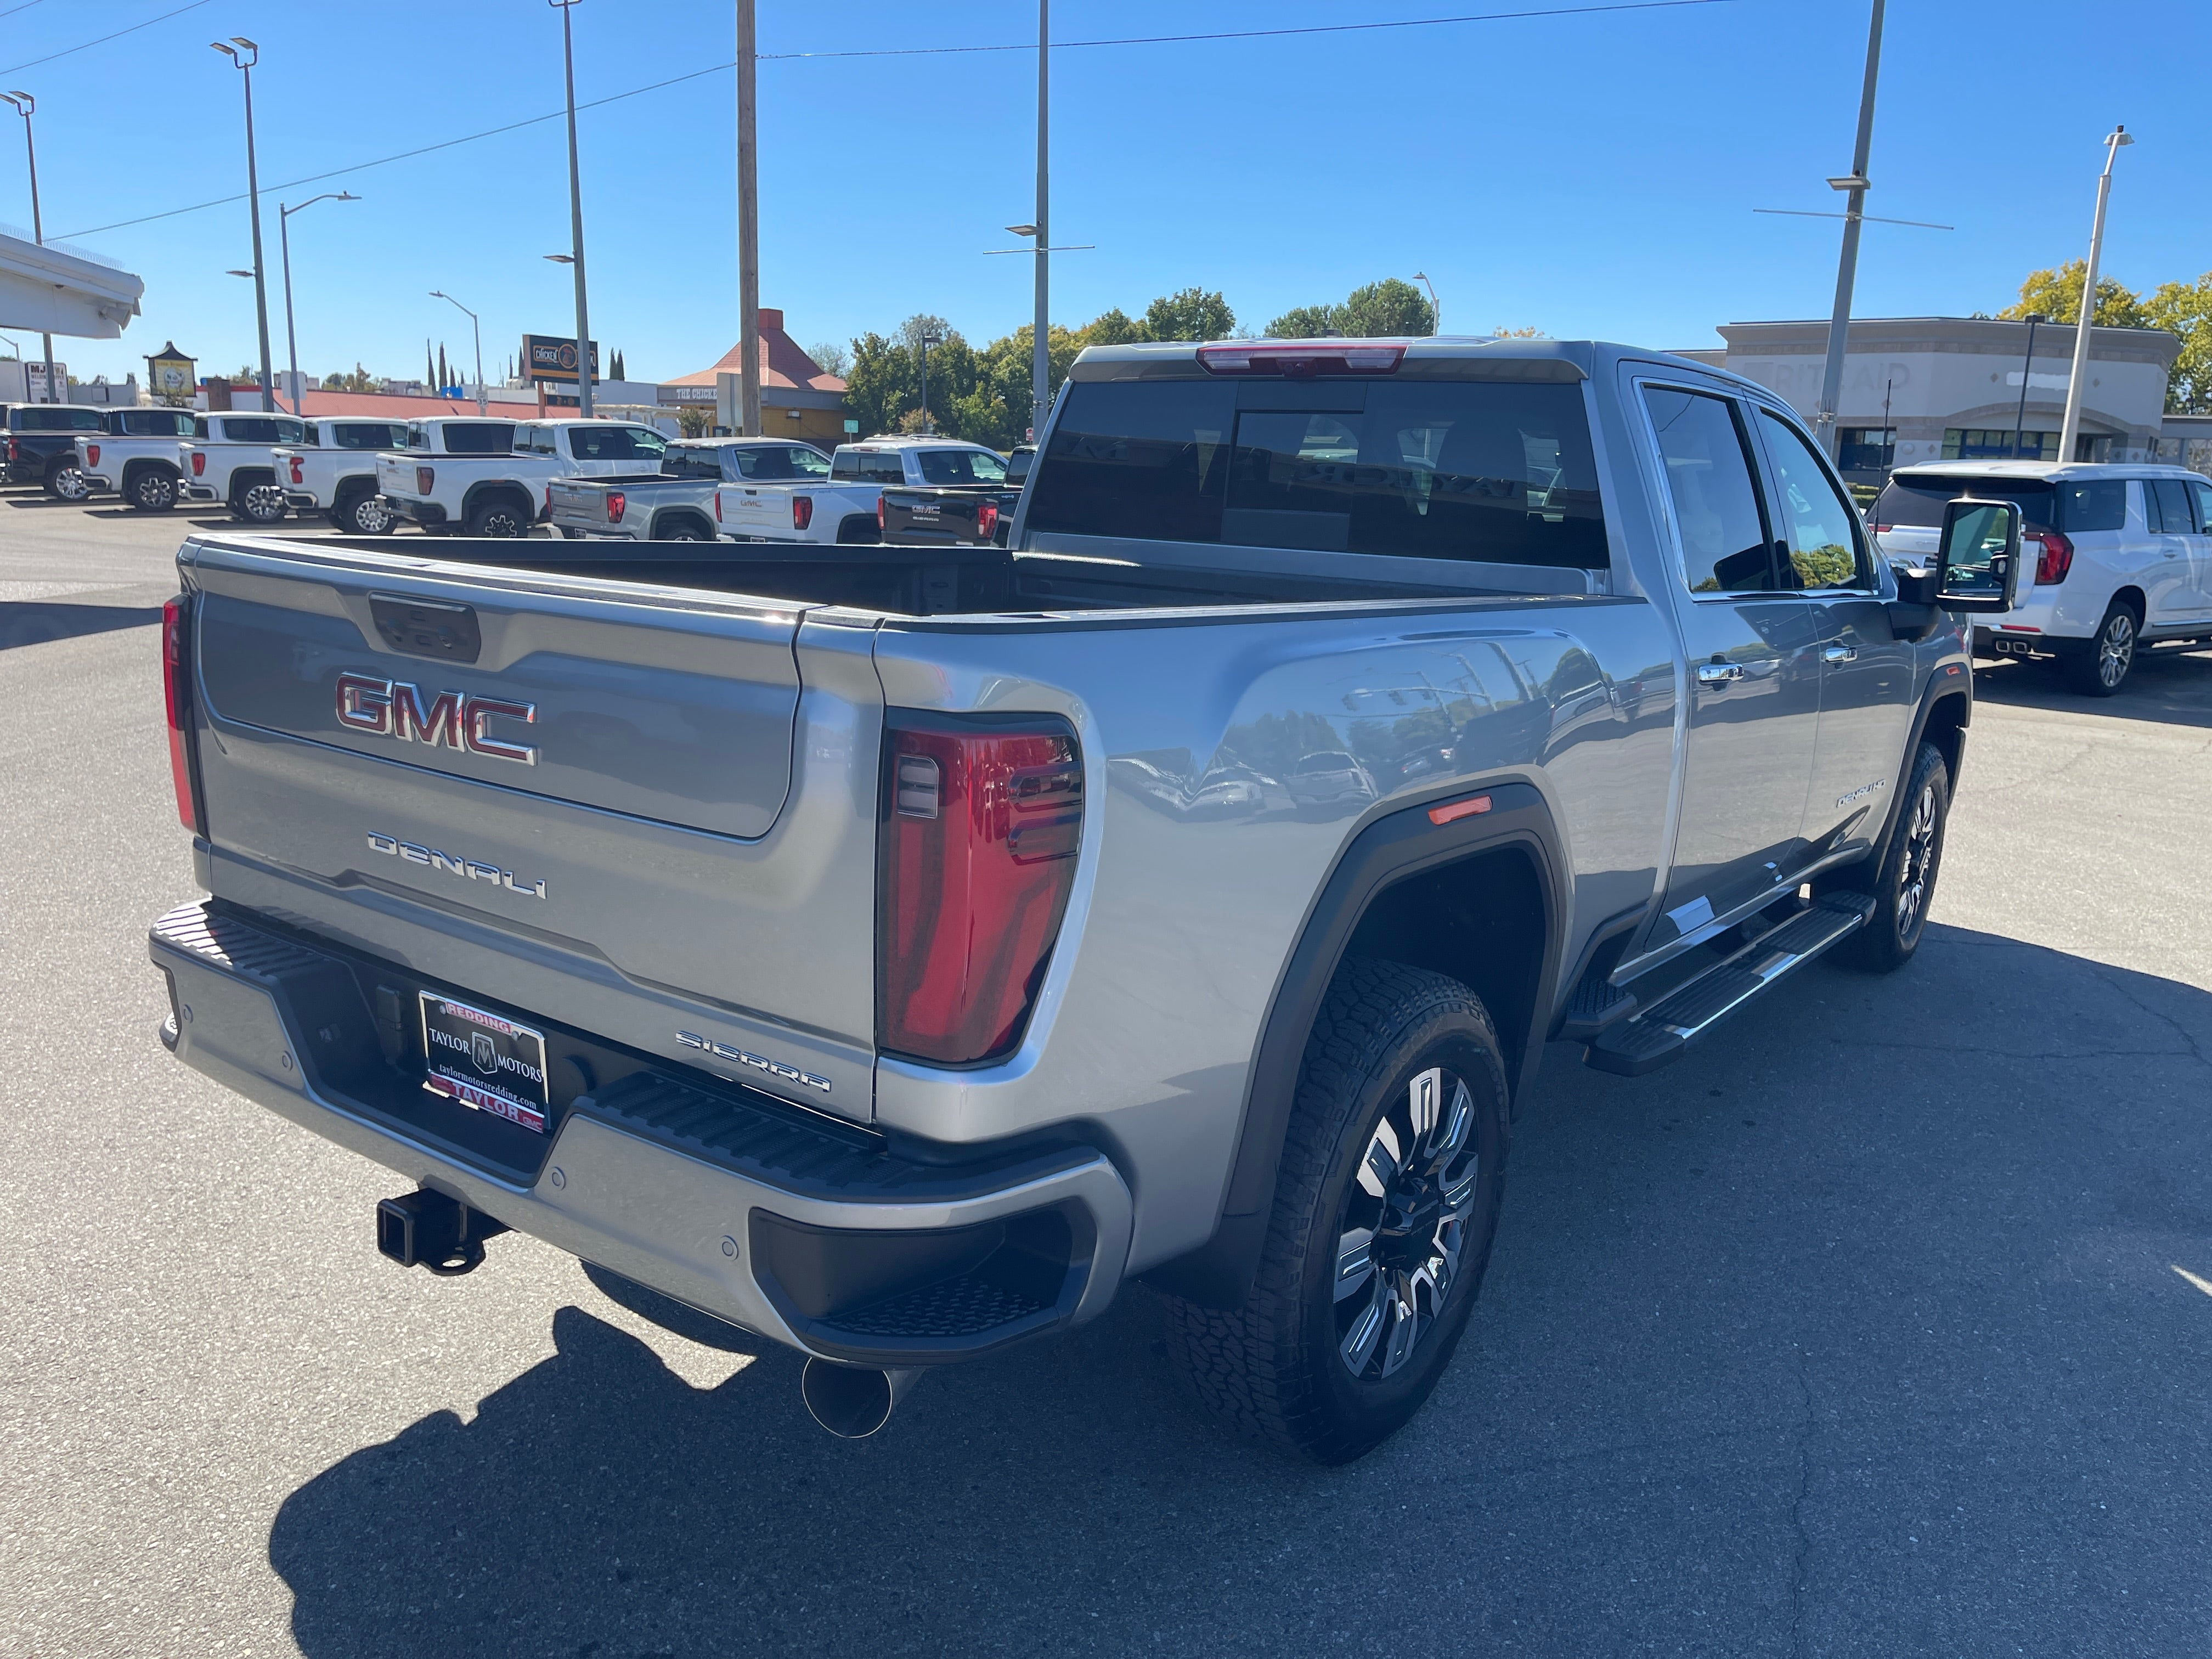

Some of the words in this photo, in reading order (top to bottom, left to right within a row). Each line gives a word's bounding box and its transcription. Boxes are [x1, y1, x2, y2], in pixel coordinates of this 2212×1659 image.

[535, 348, 558, 363] CHICKEN
[676, 388, 690, 399] THE
[692, 388, 717, 400] CHICKE
[1776, 363, 1847, 391] RIT
[912, 505, 940, 514] GMC
[335, 670, 538, 766] GMC
[1836, 783, 1873, 808] DENALI
[367, 830, 548, 900] DENALI
[447, 1003, 509, 1034] REDDING
[429, 1028, 471, 1055] TAYLOR
[497, 1053, 543, 1083] MOTORS
[675, 1030, 832, 1092] SIERRA
[439, 1063, 537, 1110] taylormotorsredding.com
[453, 1082, 520, 1121] TAYLOR
[523, 1116, 543, 1130] GMC
